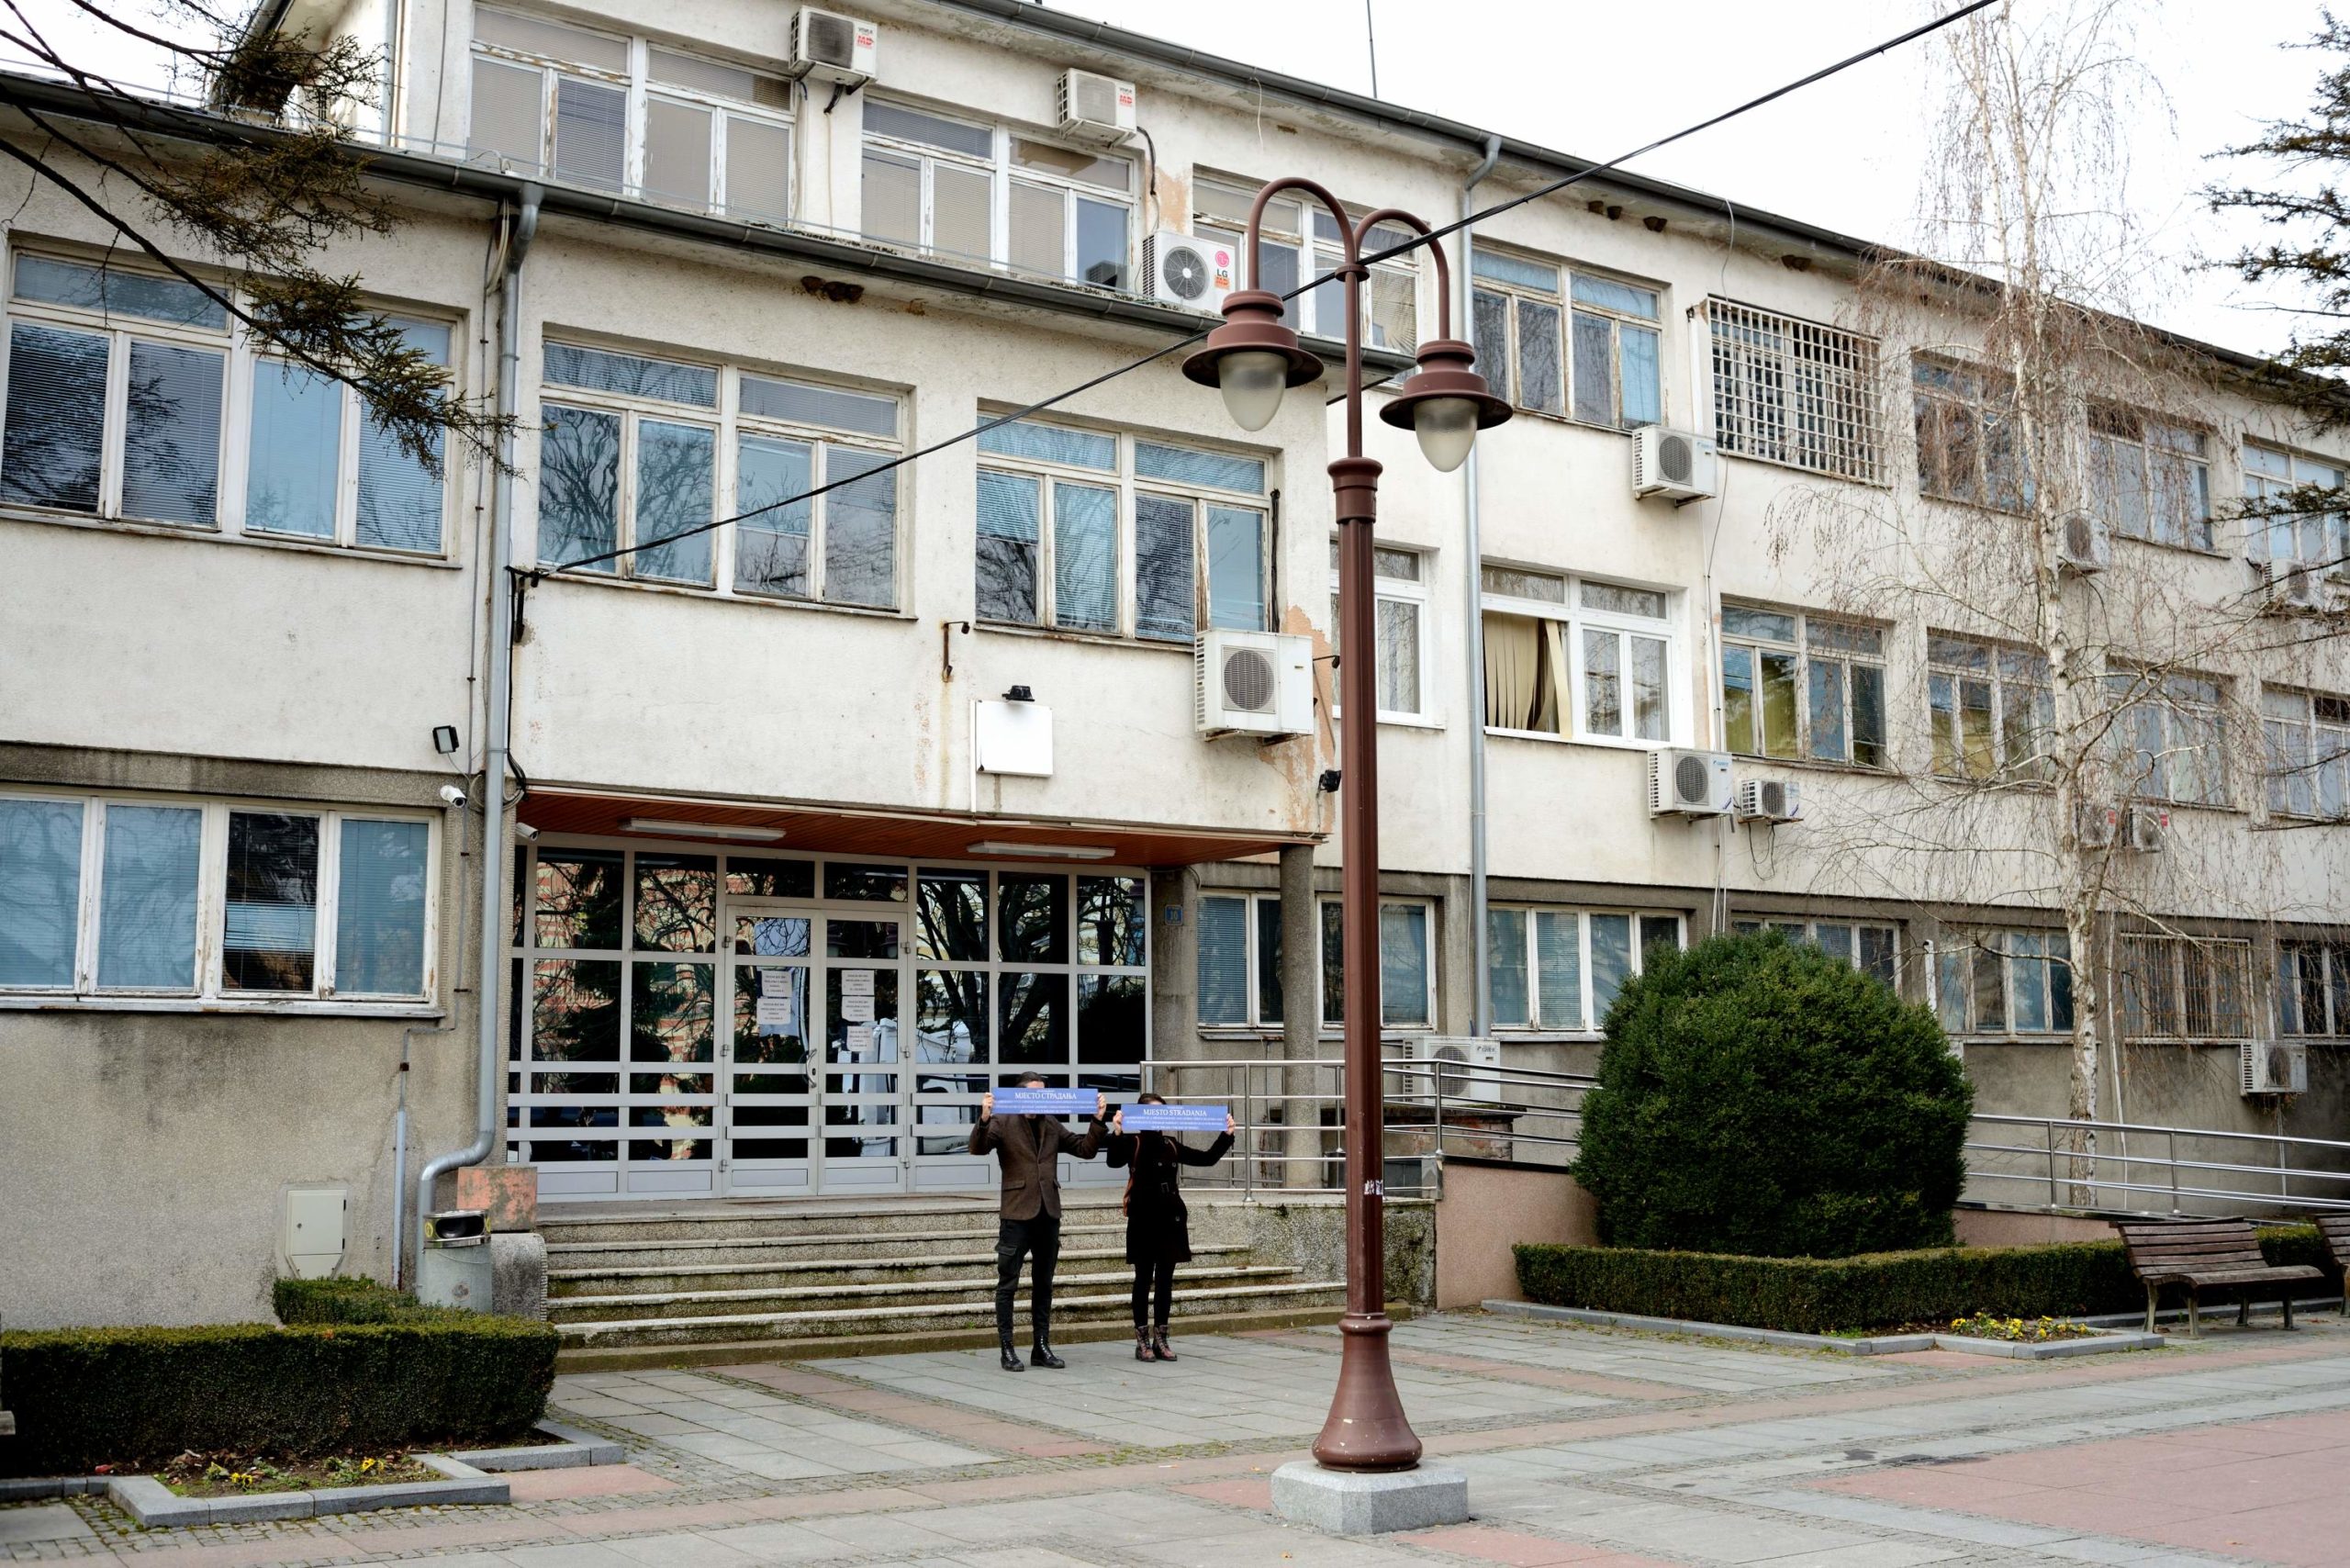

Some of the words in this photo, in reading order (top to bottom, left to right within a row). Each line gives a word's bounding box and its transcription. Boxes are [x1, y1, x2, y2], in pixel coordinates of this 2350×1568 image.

[1216, 268, 1228, 278] LG
[1014, 1092, 1041, 1100] МЈЕСТО
[1169, 1109, 1207, 1117] STRADANJA
